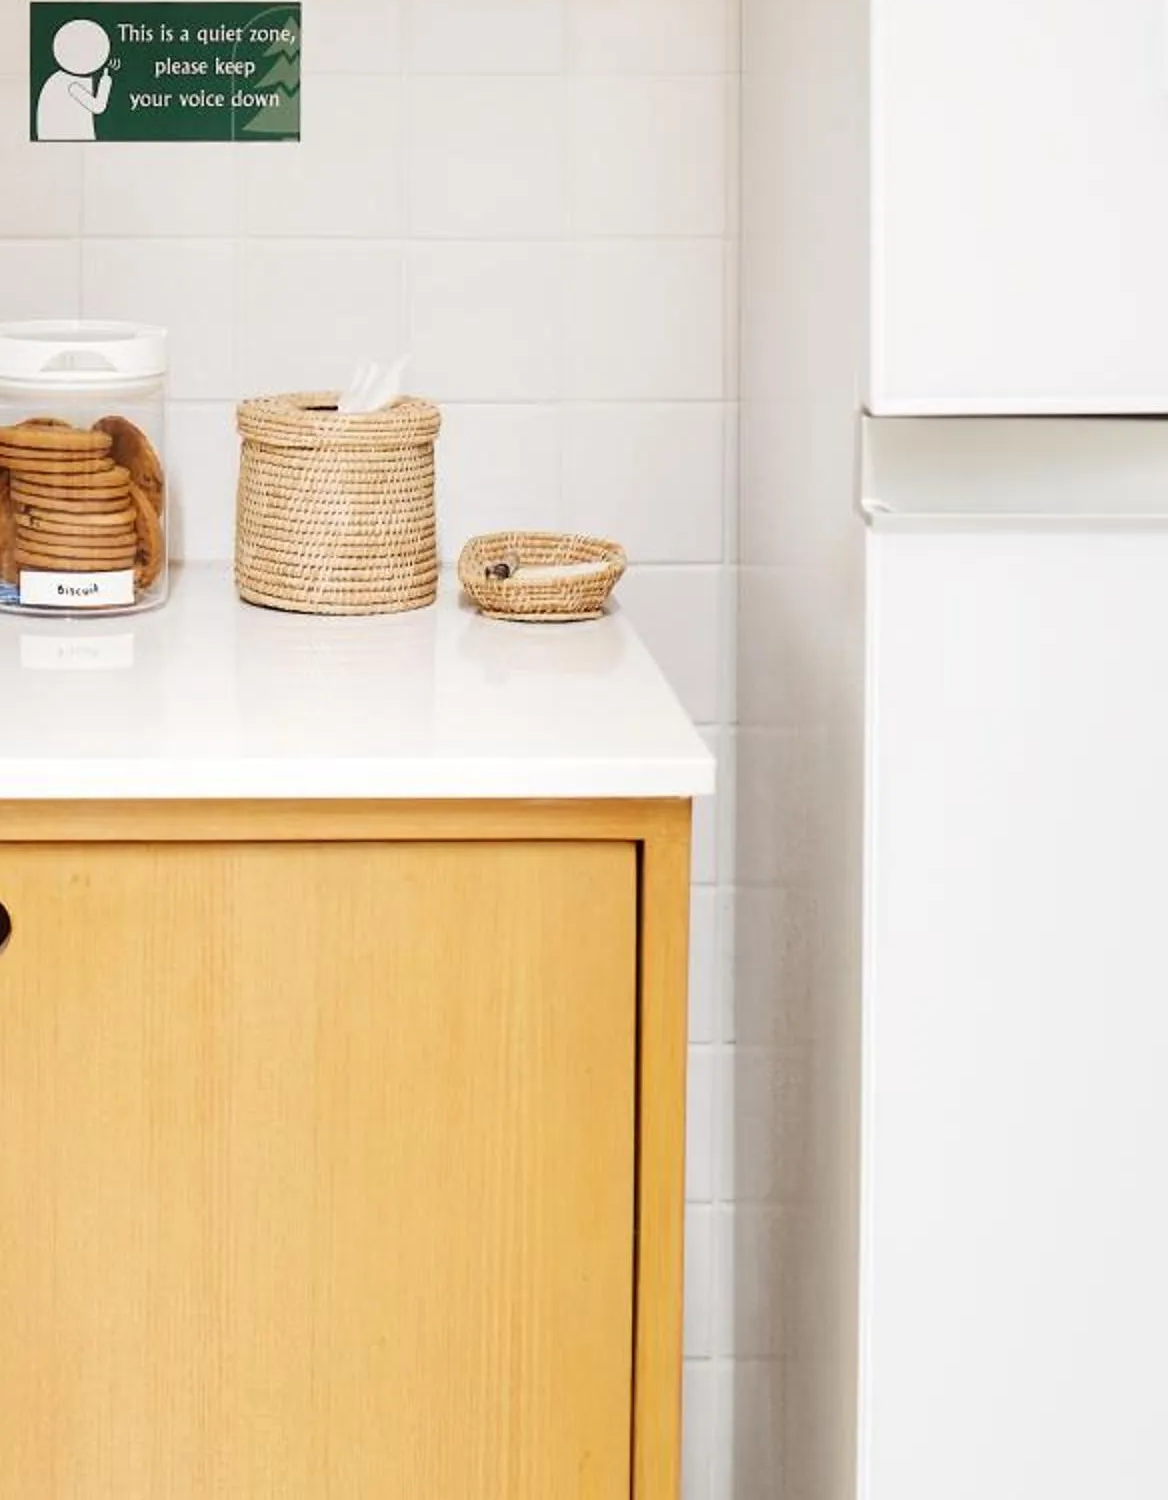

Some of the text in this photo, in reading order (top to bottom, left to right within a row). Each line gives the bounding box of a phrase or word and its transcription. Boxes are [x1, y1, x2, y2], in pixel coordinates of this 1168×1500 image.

[117, 23, 297, 46] This is a quiet zone,
[154, 57, 256, 78] please keep
[130, 90, 280, 110] your voice down
